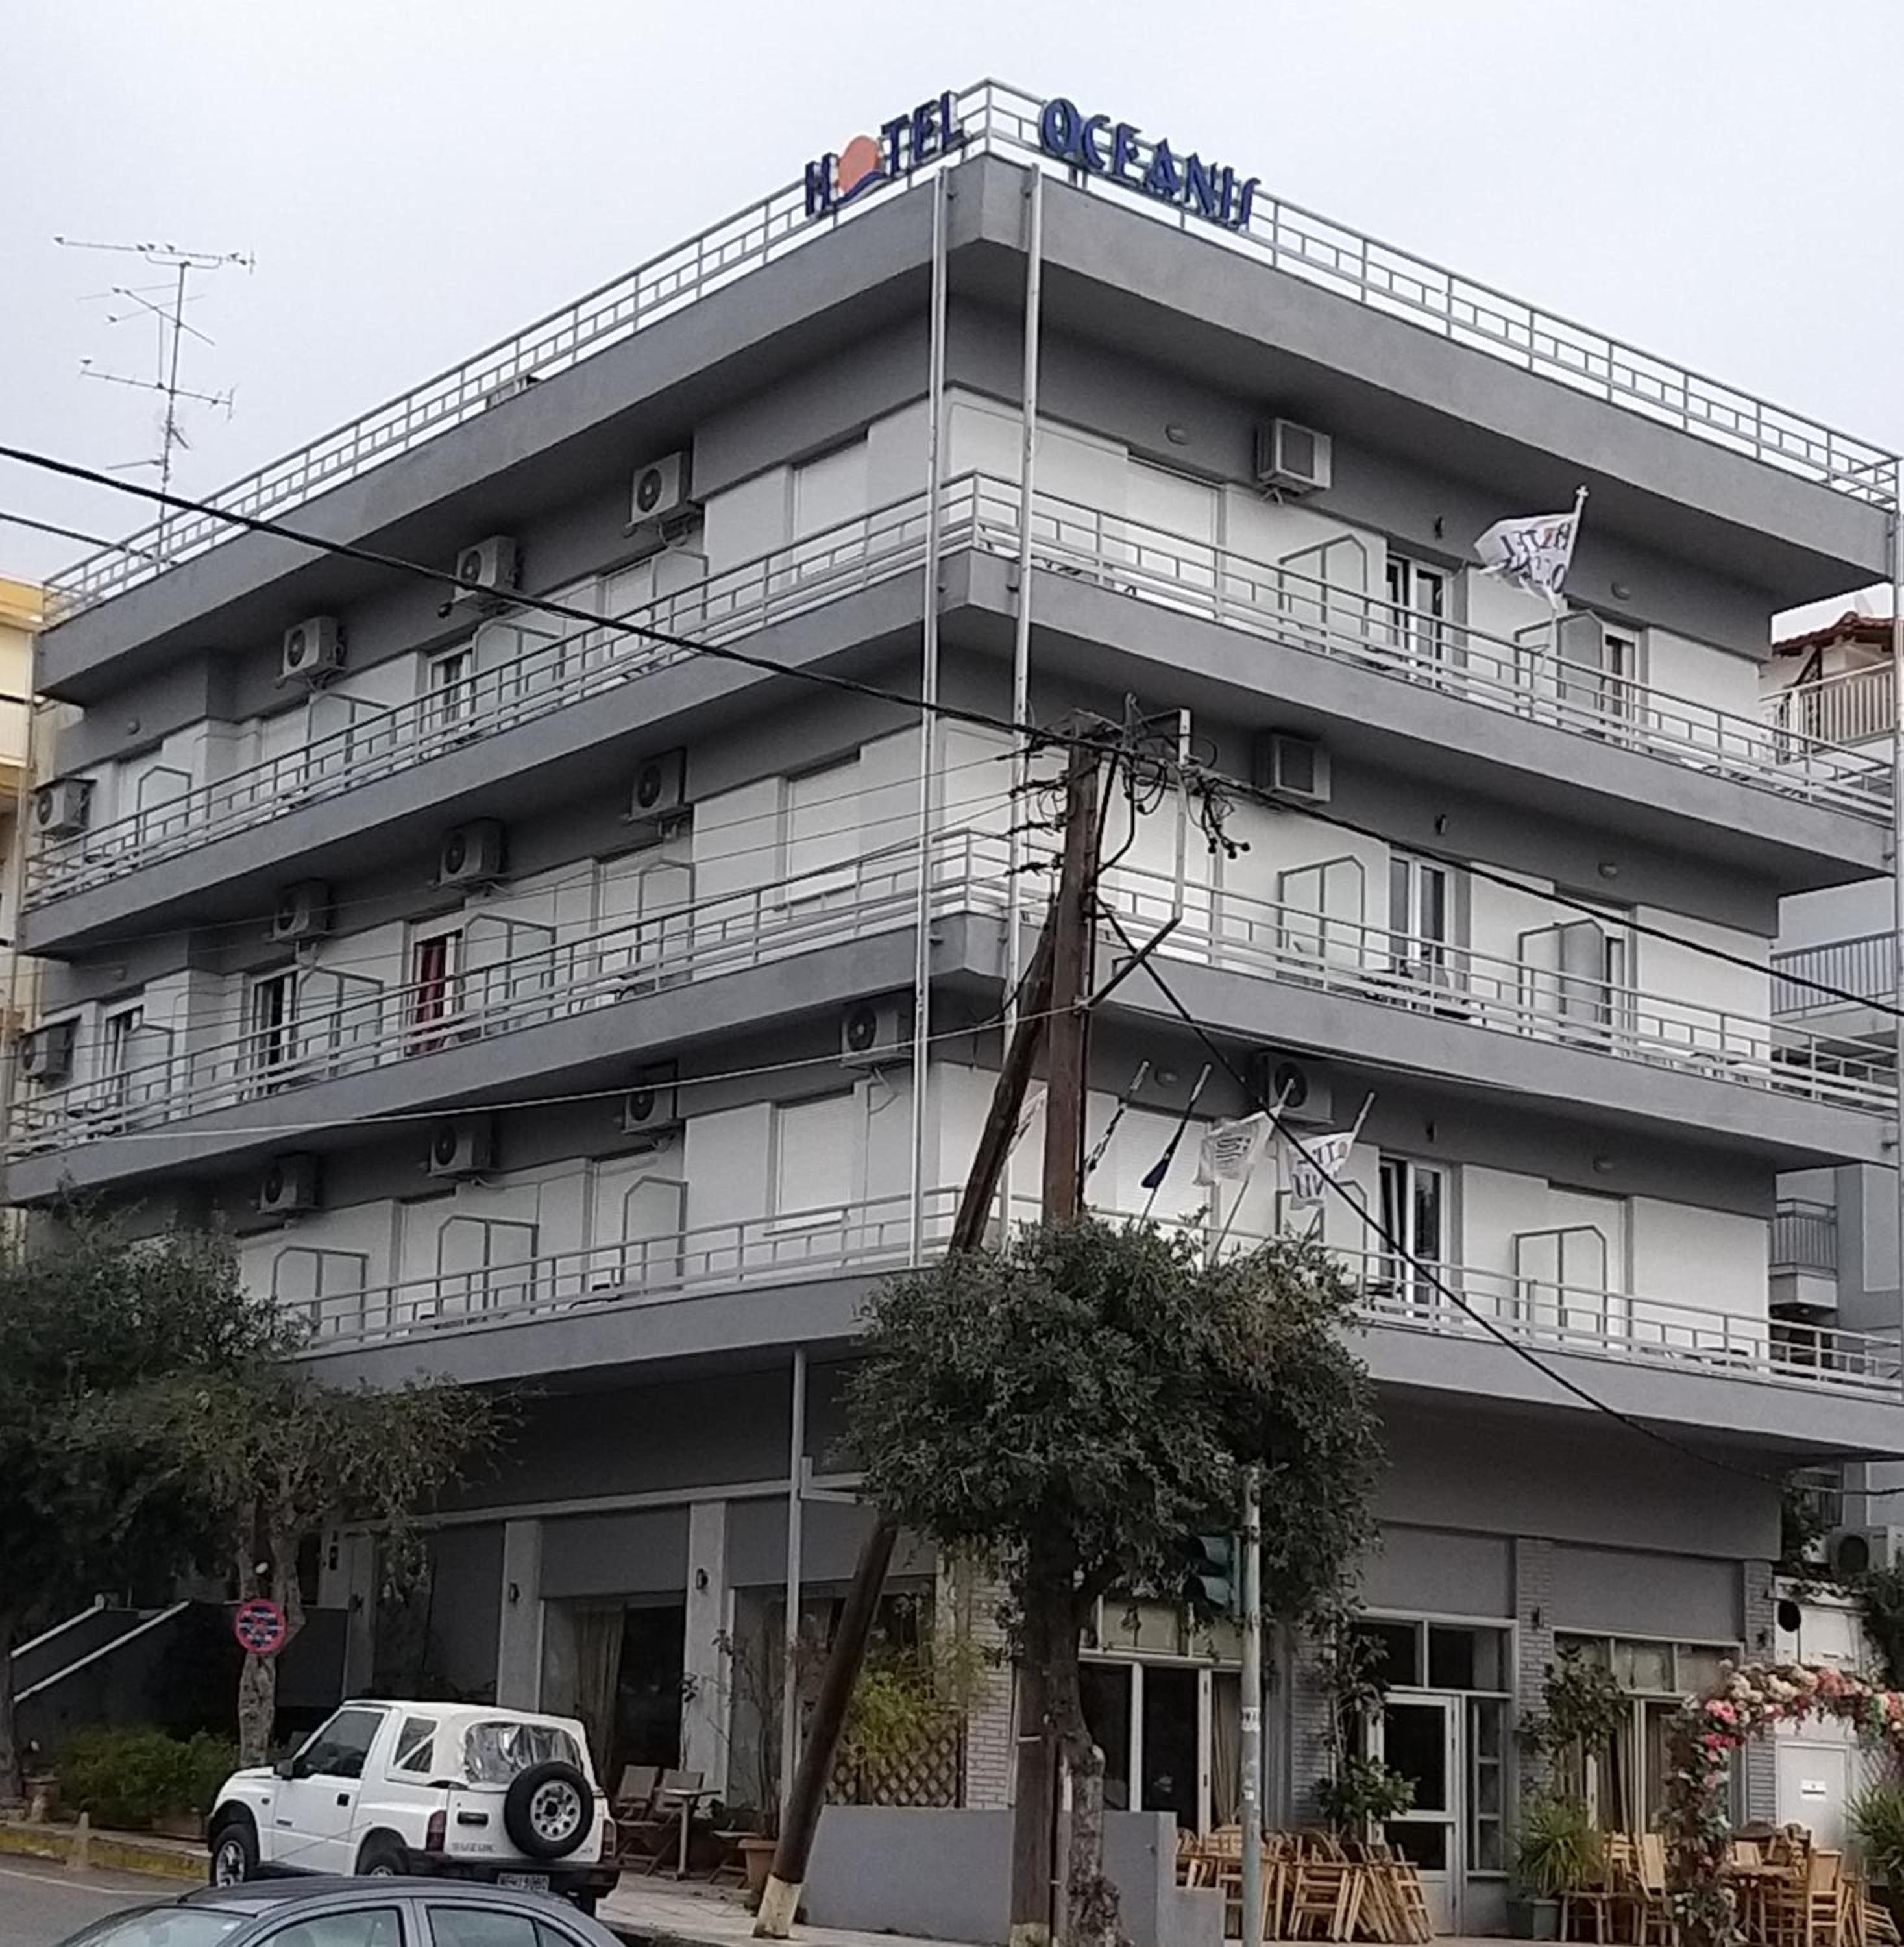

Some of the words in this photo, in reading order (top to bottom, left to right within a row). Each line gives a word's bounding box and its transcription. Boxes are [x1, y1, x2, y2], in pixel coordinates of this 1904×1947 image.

[805, 90, 964, 217] HOTEL
[1040, 98, 1261, 224] OCEANIS
[452, 1842, 494, 1853] SUZUK
